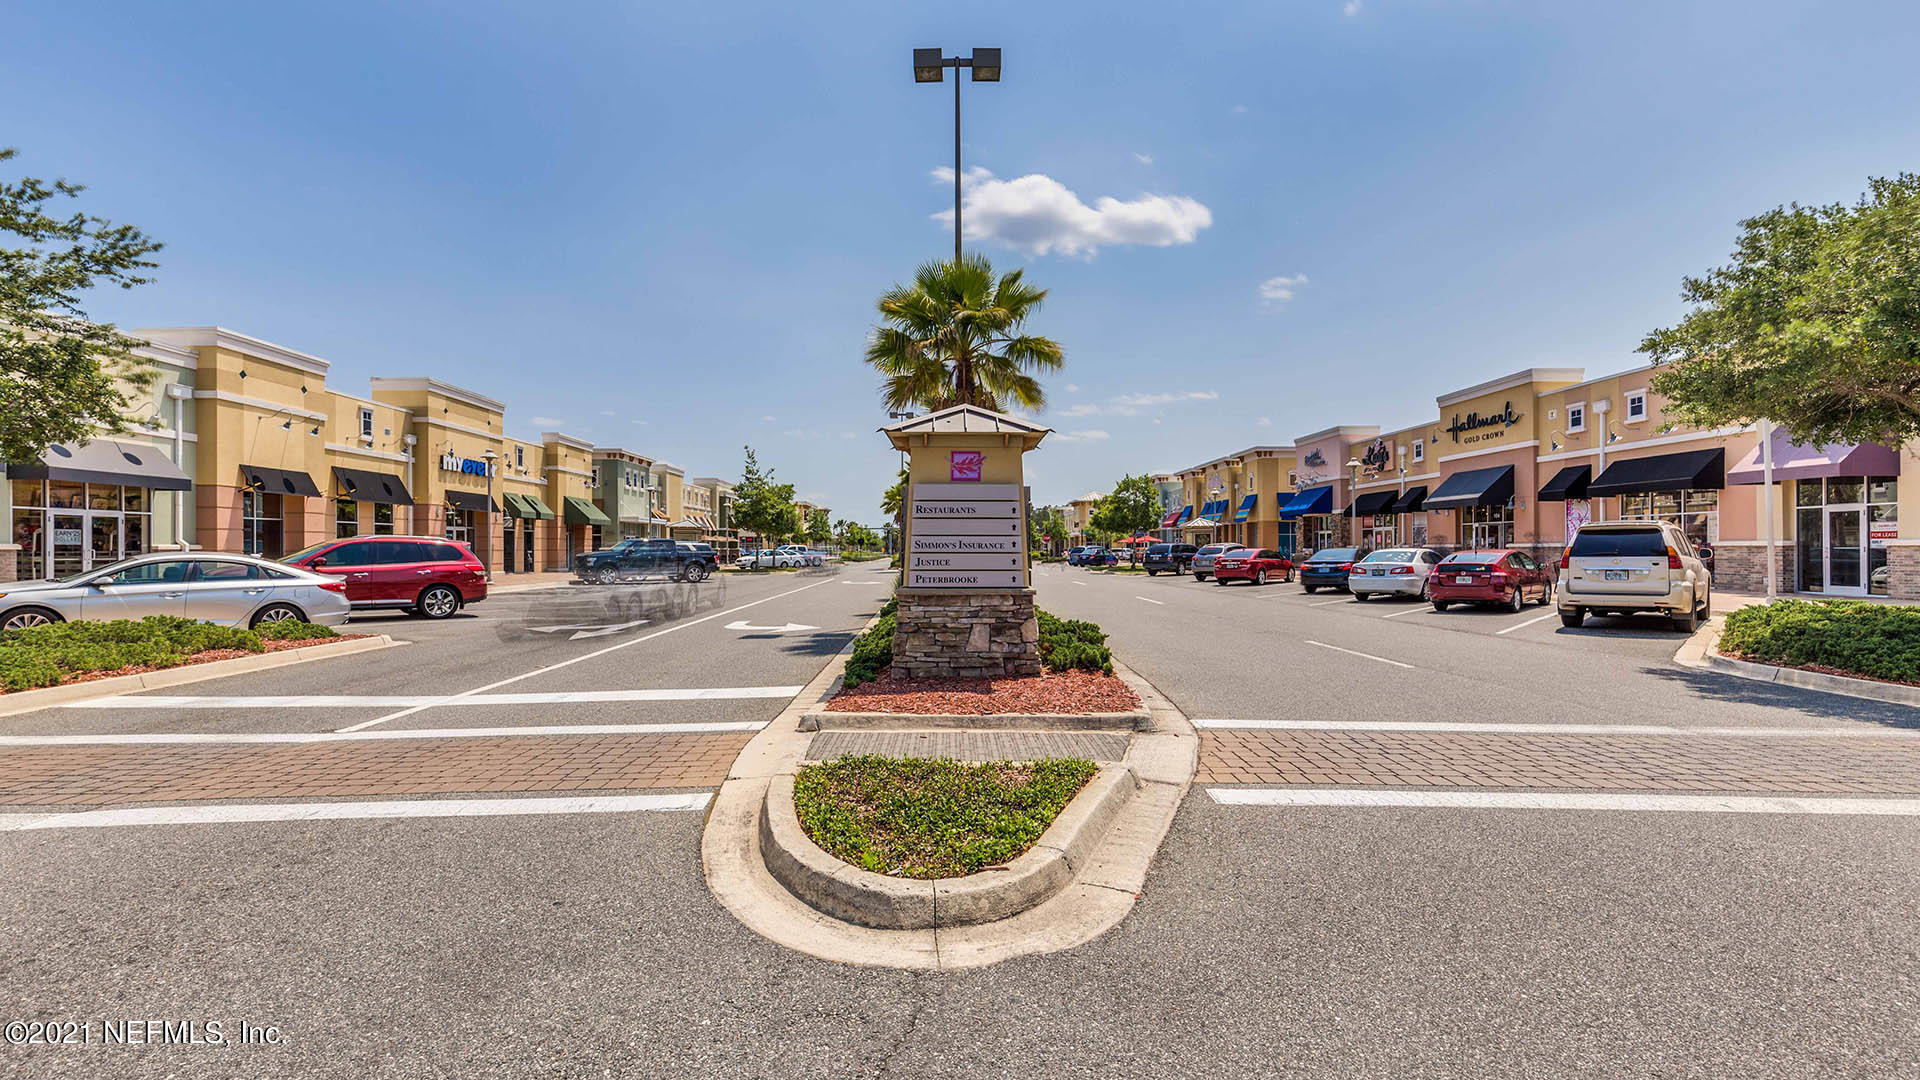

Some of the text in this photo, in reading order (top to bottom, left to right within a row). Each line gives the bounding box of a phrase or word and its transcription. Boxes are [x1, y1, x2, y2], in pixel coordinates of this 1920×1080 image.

[1446, 401, 1520, 444] Hallmark
[1464, 430, 1505, 444] GOLD CROWN
[915, 505, 977, 514] RESTAURANTS
[914, 540, 1005, 549] SIMMON'S INSURANCE
[915, 557, 951, 567] JUSTICE
[915, 575, 979, 584] PETERBROOKE
